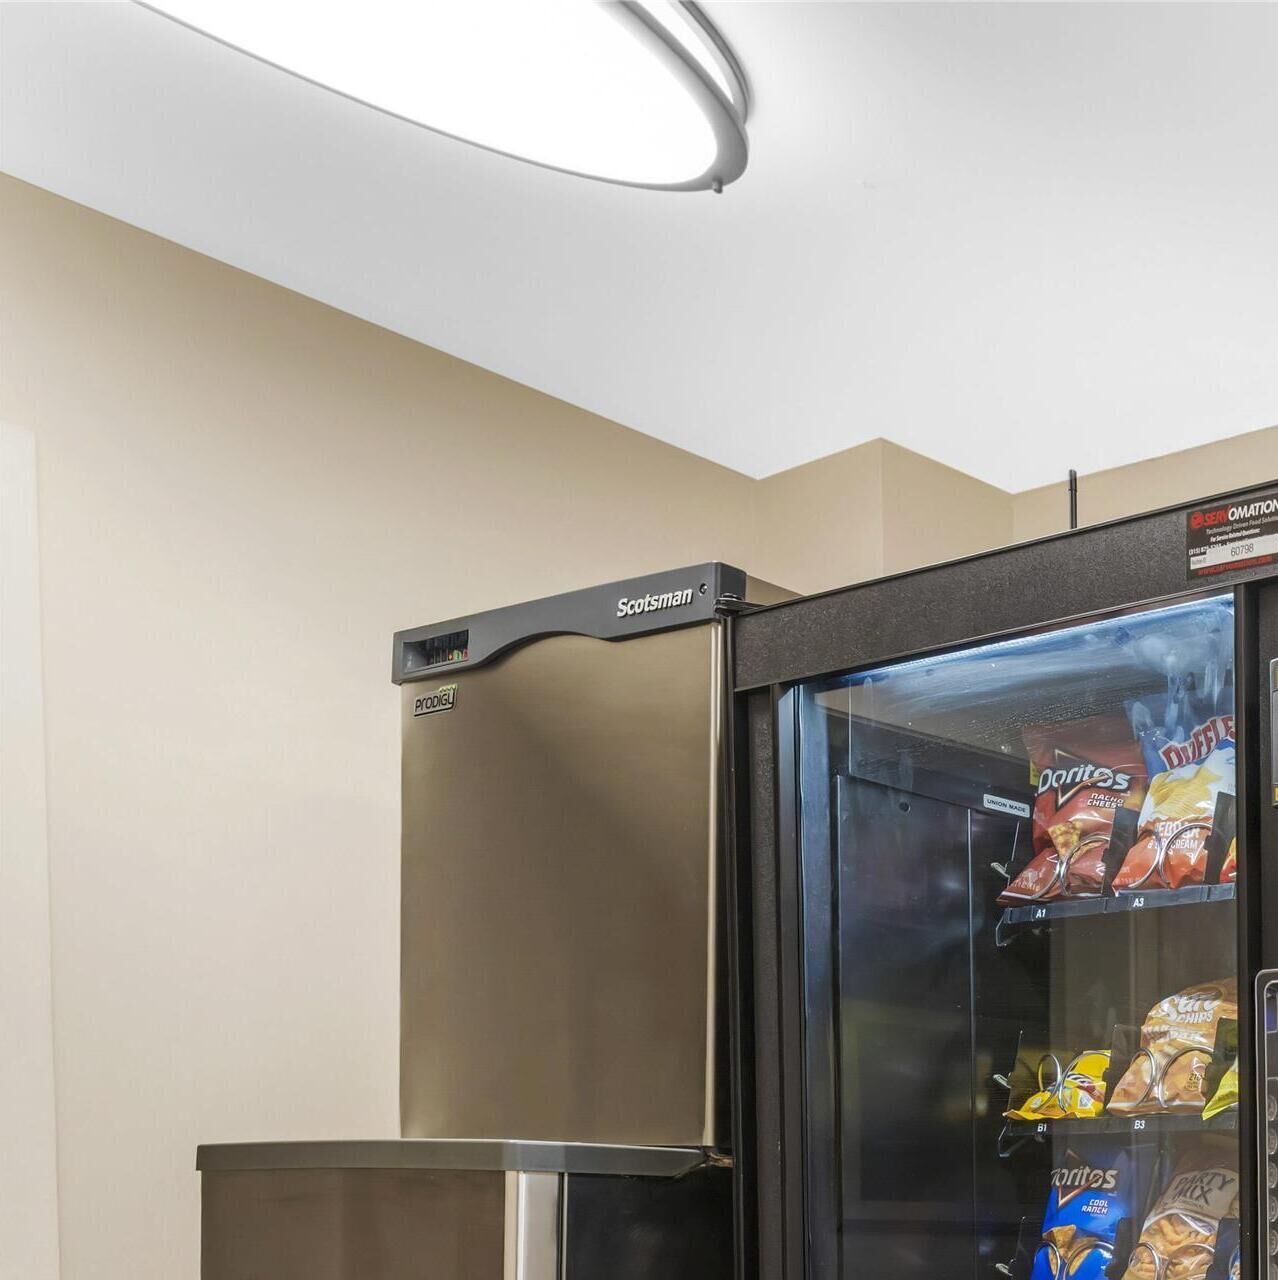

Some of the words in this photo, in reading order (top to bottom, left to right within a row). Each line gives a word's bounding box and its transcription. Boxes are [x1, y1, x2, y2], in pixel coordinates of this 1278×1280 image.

[1231, 543, 1254, 556] 60798
[617, 588, 693, 617] Scotsman
[1038, 763, 1131, 794] Doritos
[987, 799, 1006, 809] UNION
[1007, 803, 1026, 813] MADE
[1133, 898, 1144, 907] A3
[1036, 909, 1046, 918] A1
[1037, 1123, 1047, 1133] B1
[1134, 1120, 1145, 1130] B3
[1082, 1205, 1108, 1214] RANCH
